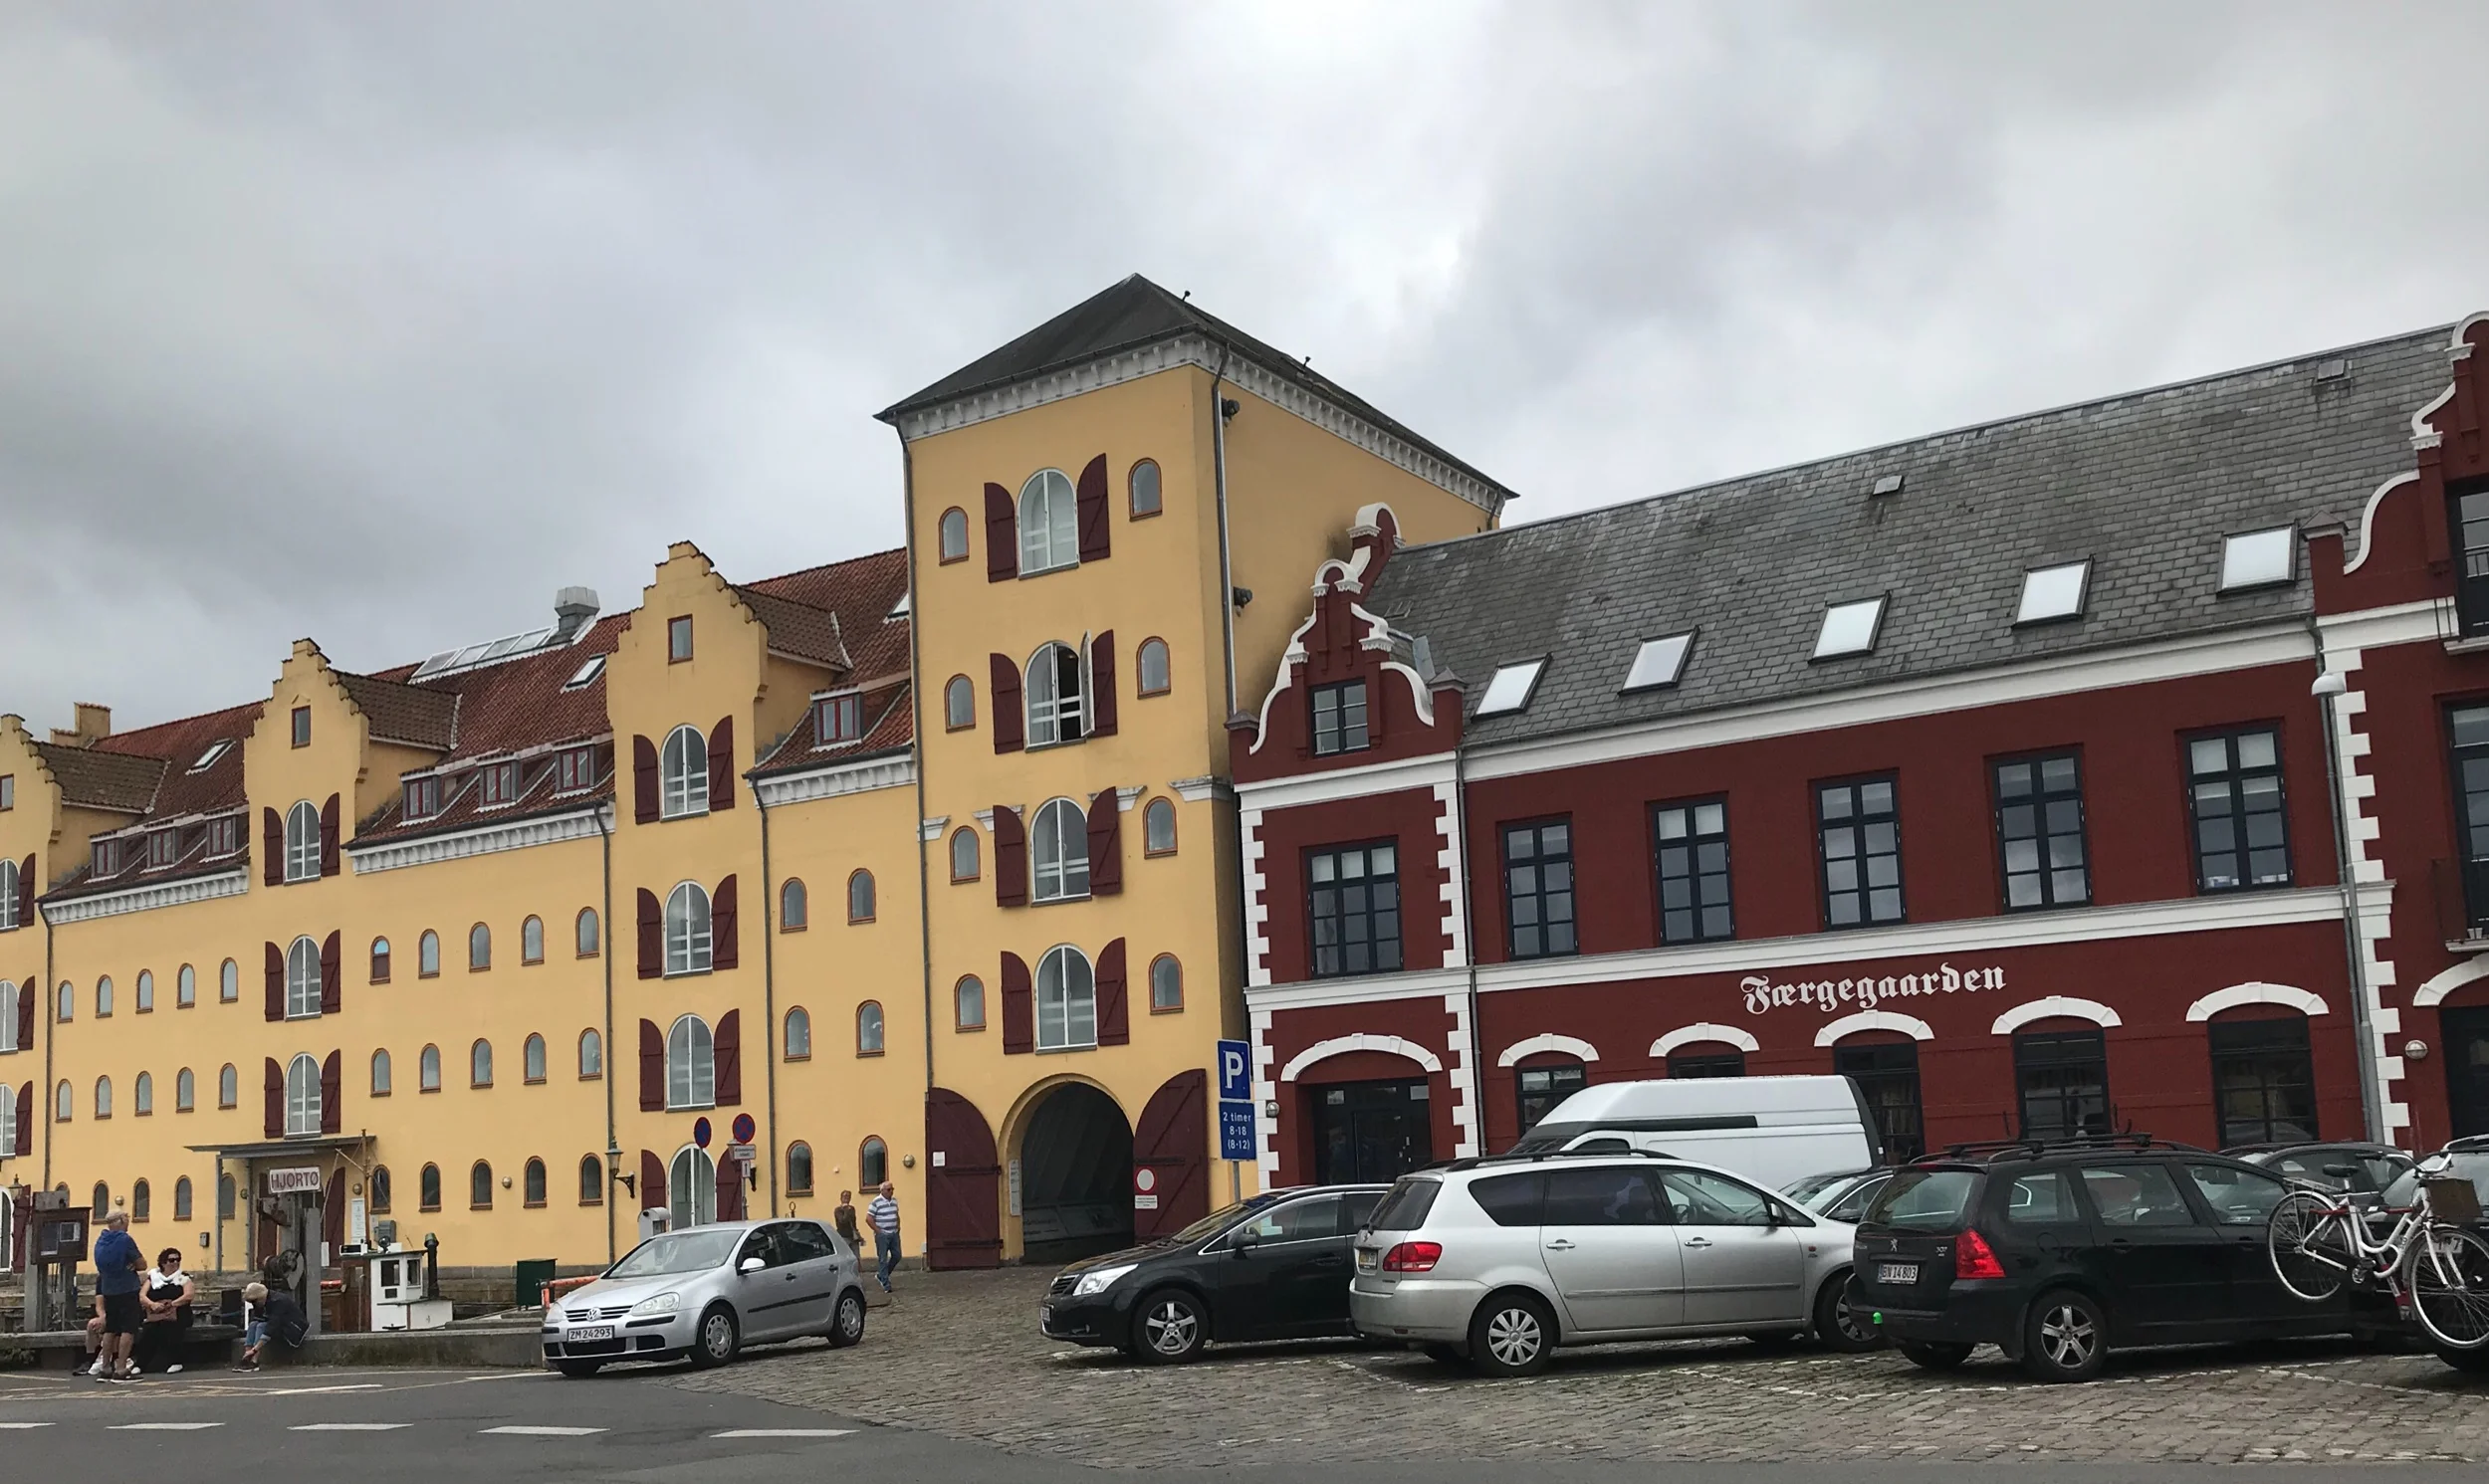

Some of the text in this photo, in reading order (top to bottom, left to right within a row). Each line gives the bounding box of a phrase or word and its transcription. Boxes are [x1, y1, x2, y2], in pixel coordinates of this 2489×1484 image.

[1740, 961, 2007, 1015] Færgegaarden
[1225, 1050, 1244, 1089] P
[1223, 1112, 1251, 1123] 2 timer
[1229, 1126, 1247, 1136] 8-18
[1228, 1140, 1250, 1151] (8-12)
[271, 1171, 320, 1188] HJORTØ
